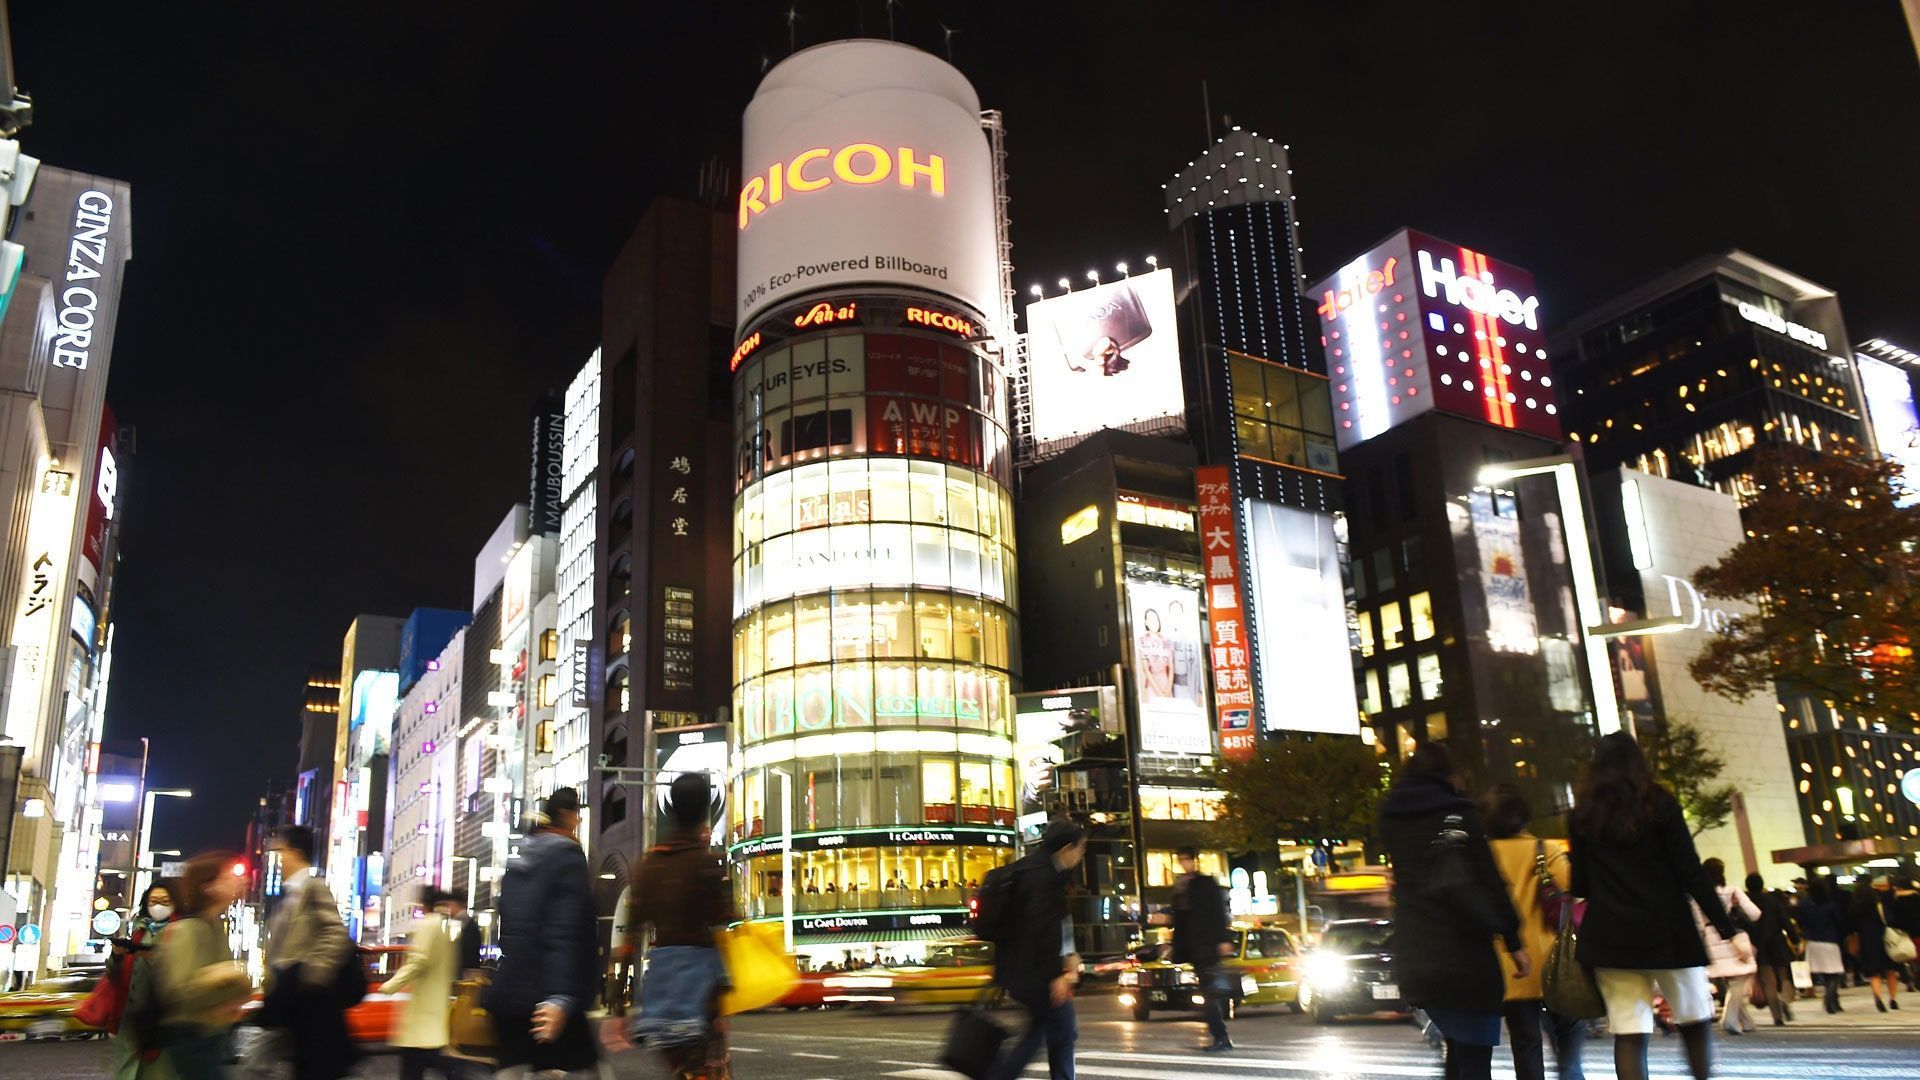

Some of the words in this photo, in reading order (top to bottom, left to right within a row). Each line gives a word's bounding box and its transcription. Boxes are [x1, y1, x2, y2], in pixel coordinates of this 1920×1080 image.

[738, 142, 946, 230] RICOH
[67, 190, 113, 282] GINZA
[743, 283, 766, 311] 100%
[770, 256, 869, 290] Eco-Powered
[875, 255, 948, 280] Billboard
[1417, 249, 1540, 331] Haier
[53, 287, 98, 370] CORE
[906, 307, 971, 336] RICOH
[792, 359, 851, 380] EYES.
[545, 414, 565, 526] MAUBOUSSIN
[1197, 482, 1229, 496] ブランド
[1199, 504, 1231, 517] チケット
[25, 551, 52, 617] トラジ
[1205, 525, 1238, 610] 大黒屋
[574, 646, 587, 703] TASAKI
[1213, 646, 1247, 669] 買取
[1215, 668, 1249, 691] 販売
[875, 695, 980, 717] COSMETICS
